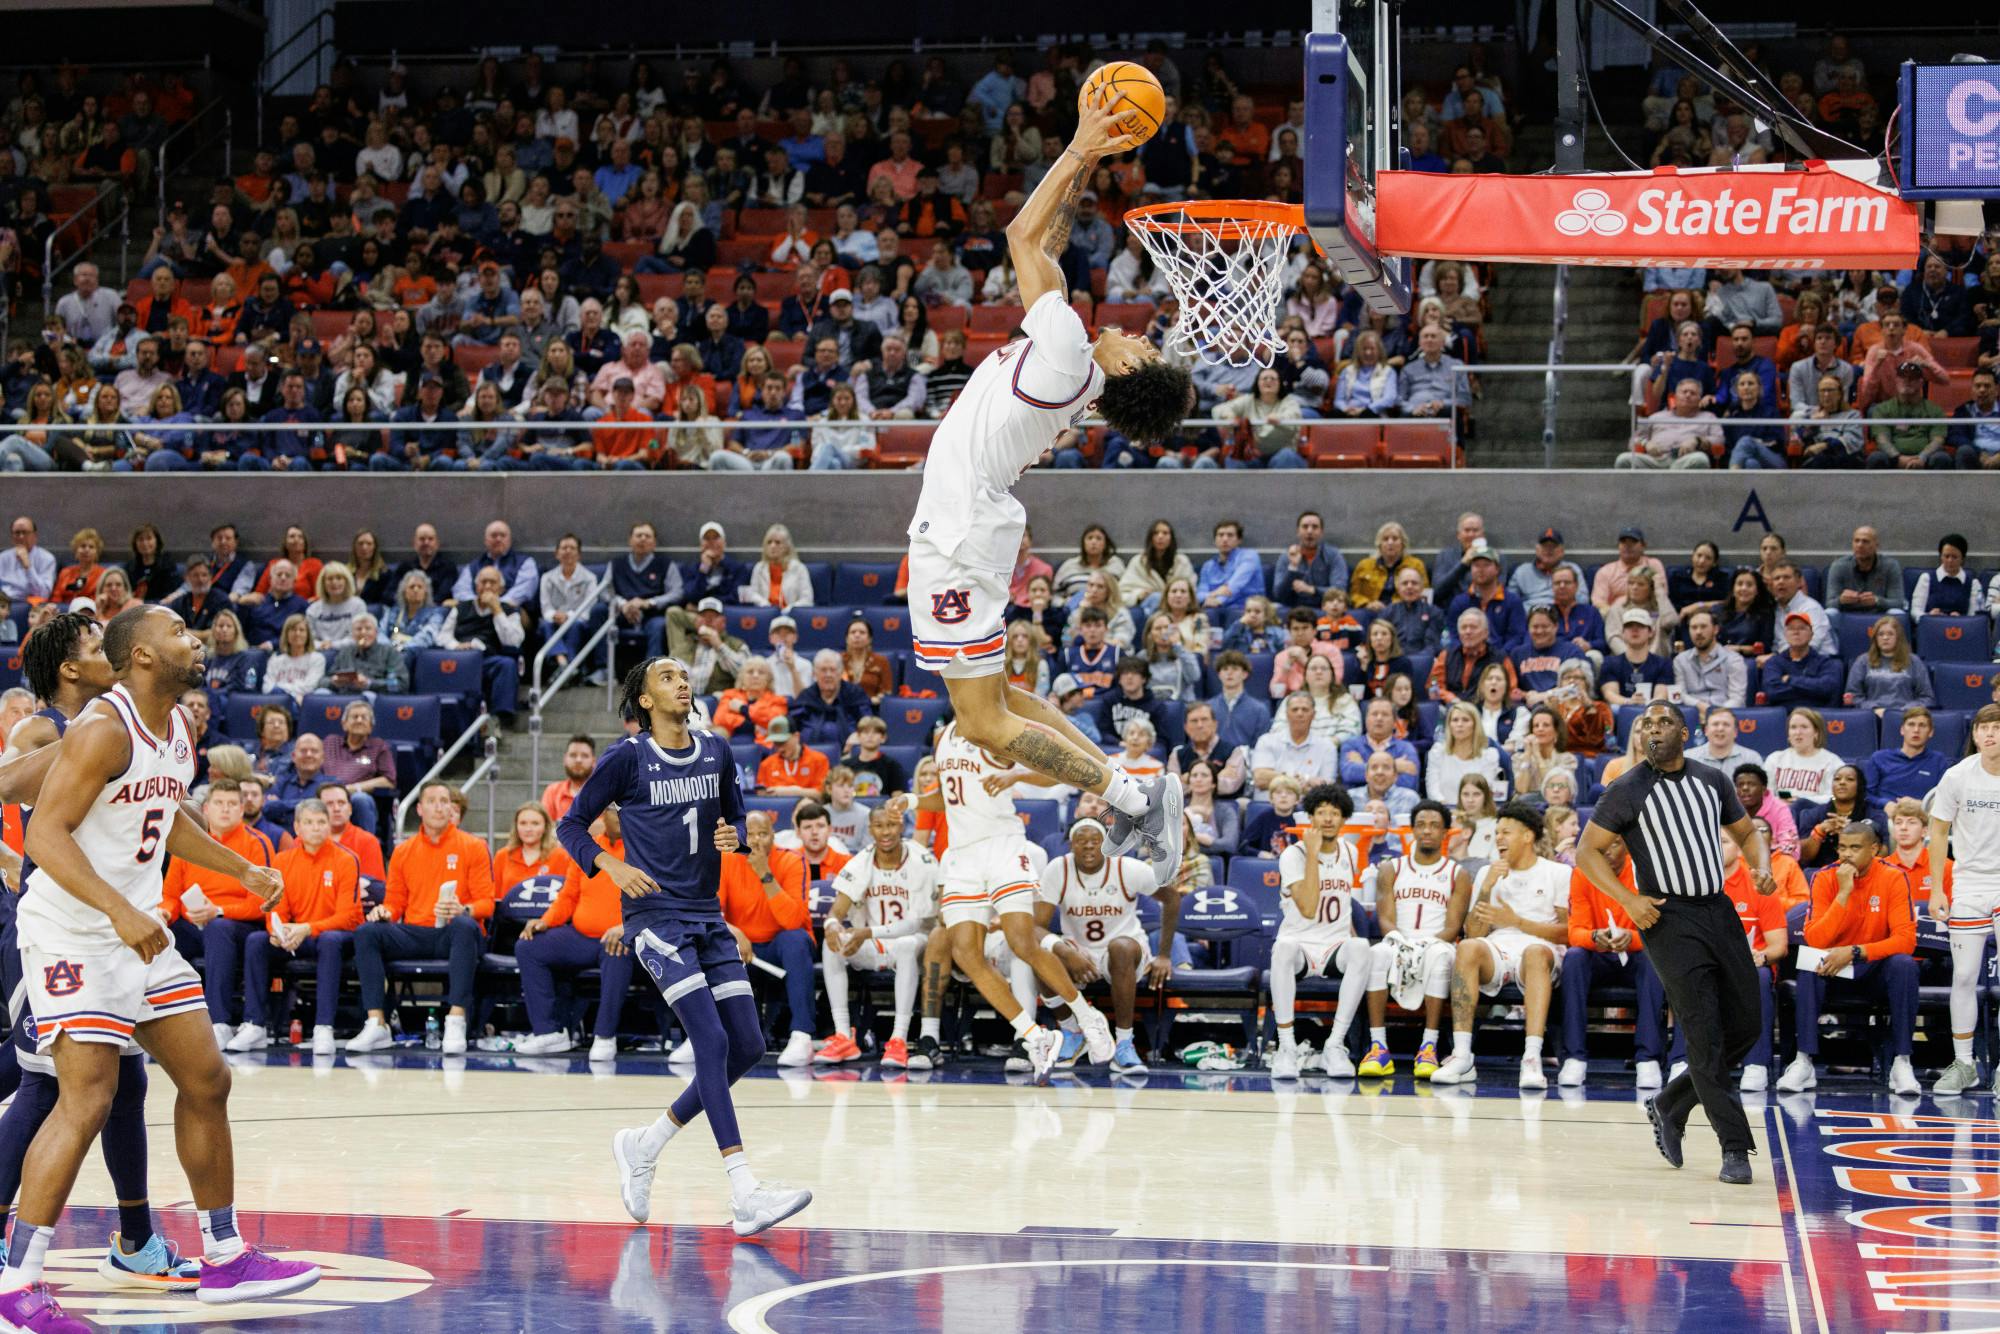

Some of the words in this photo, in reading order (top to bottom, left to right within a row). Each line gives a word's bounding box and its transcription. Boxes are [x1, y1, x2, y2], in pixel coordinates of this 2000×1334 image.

[1633, 188, 1753, 235] State
[1765, 187, 1888, 235] Farm
[1692, 257, 1825, 269] Farm
[1732, 487, 1772, 533] A
[938, 758, 981, 774] UBURN
[109, 776, 188, 804] AUBURN
[649, 773, 720, 806] MONMOUTH
[946, 776, 966, 806] 31
[1775, 767, 1825, 793] AUBURN
[134, 808, 164, 864] 5
[682, 807, 699, 855] 1
[1319, 879, 1351, 895] UBURN
[1395, 887, 1448, 907] AUBURN
[880, 899, 904, 926] 13
[1067, 905, 1122, 916] AUBURN
[1318, 895, 1341, 924] 10
[1414, 903, 1423, 930] 1
[1085, 919, 1106, 943] 8
[1922, 933, 1950, 943] ARMOU
